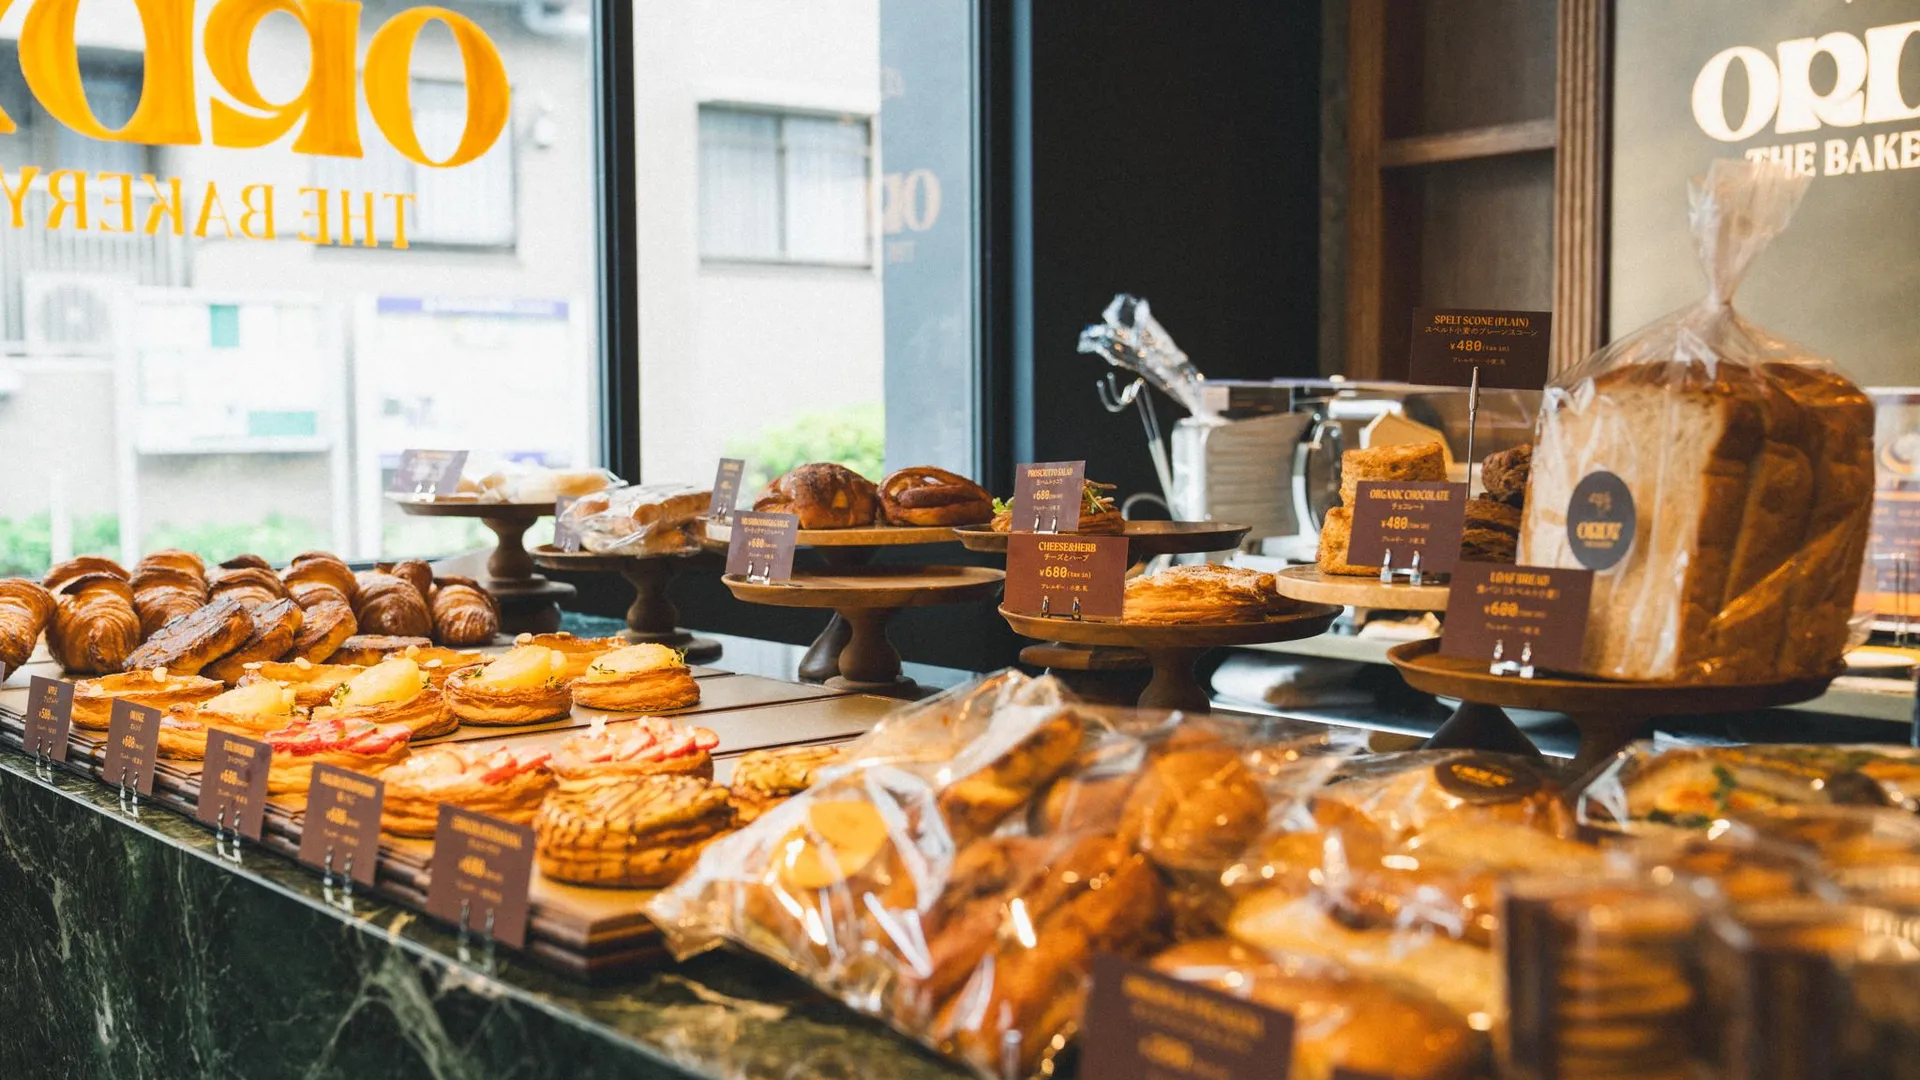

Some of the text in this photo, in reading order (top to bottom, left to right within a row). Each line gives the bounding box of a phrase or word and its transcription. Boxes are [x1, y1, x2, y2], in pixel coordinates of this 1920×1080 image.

[1745, 142, 1816, 179] THE
[1434, 315, 1529, 327] SPELT SCONE (PLAIN)
[1038, 541, 1096, 552] CHEESE&HERB
[1039, 566, 1067, 578] ¥680
